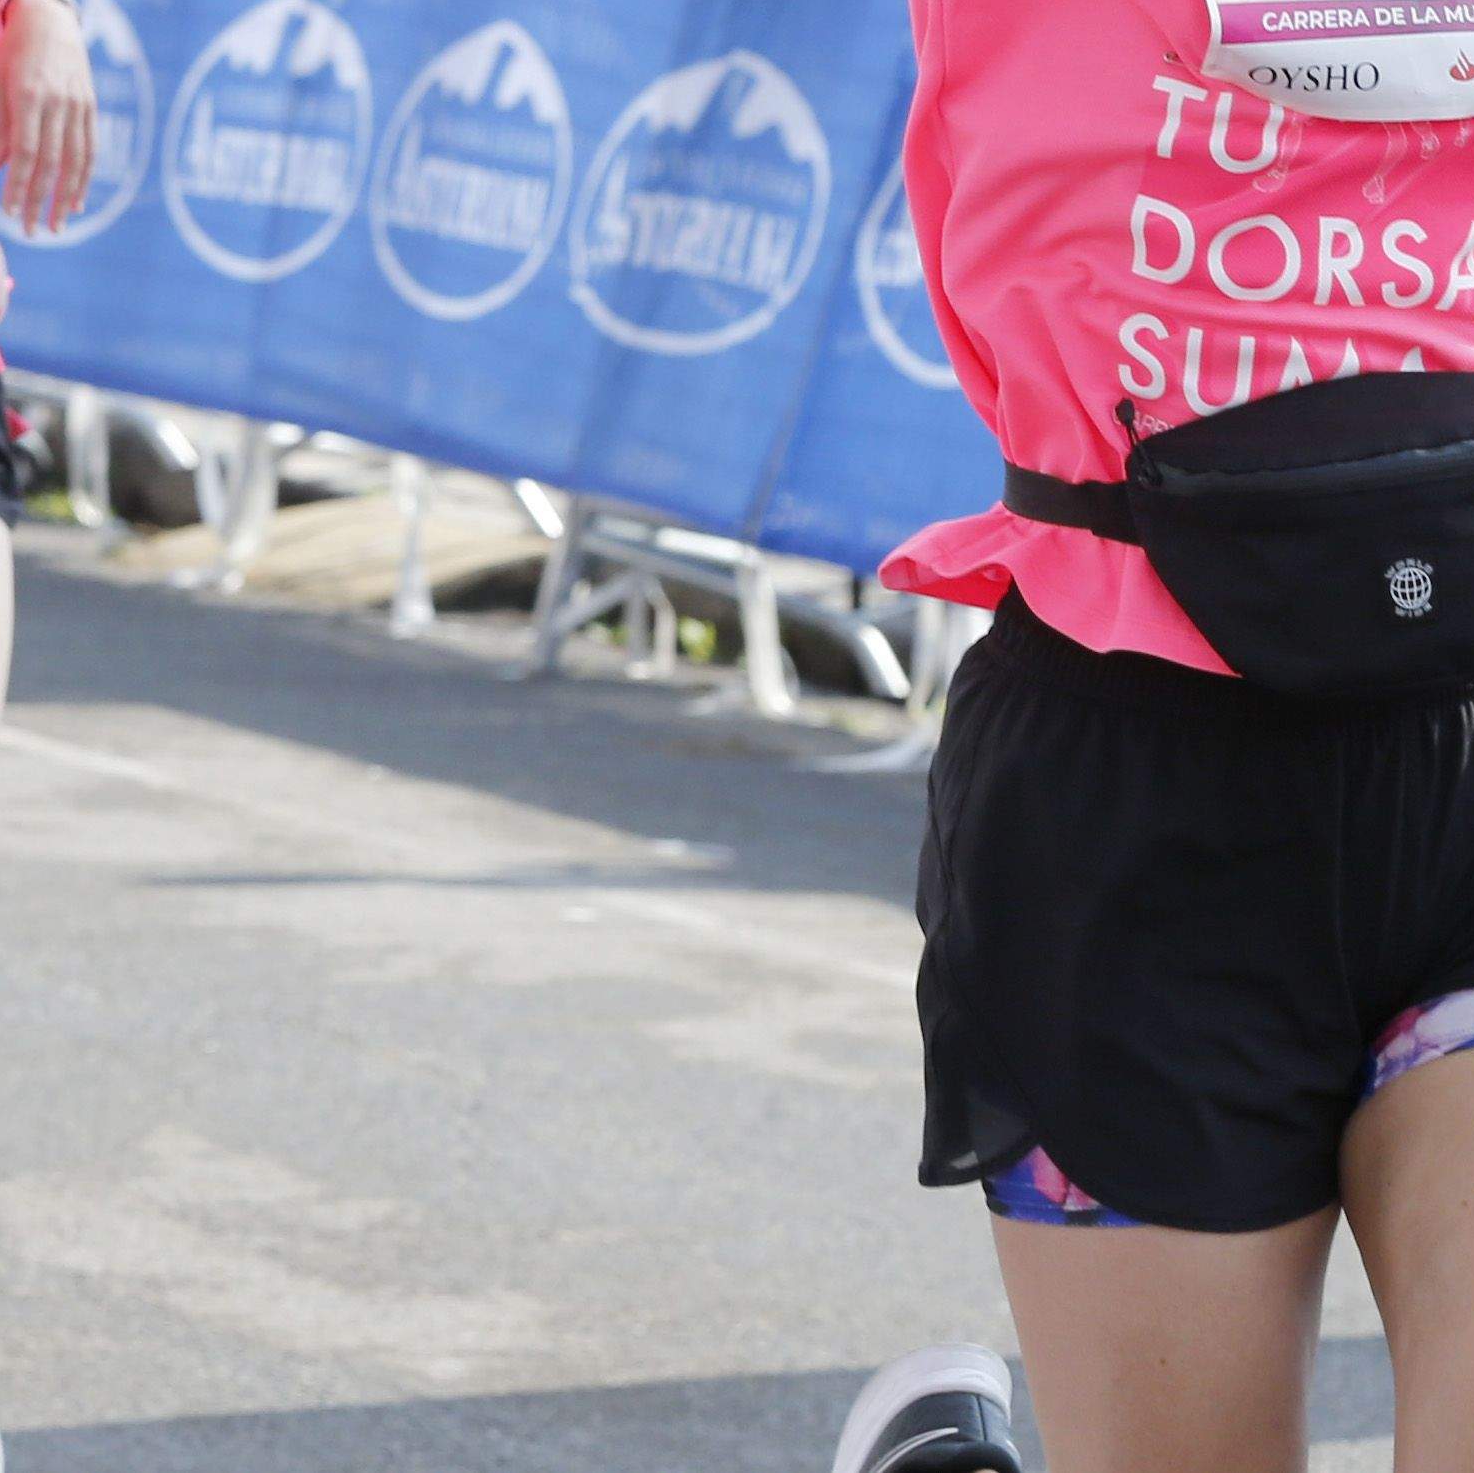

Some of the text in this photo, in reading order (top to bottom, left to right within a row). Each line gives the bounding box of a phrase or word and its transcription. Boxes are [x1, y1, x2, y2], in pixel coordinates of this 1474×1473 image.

[1262, 9, 1370, 32] CARRERA
[1375, 7, 1408, 26] DE
[1412, 7, 1443, 25] LA
[1248, 61, 1380, 92] OYSHO
[1153, 74, 1284, 176] TU
